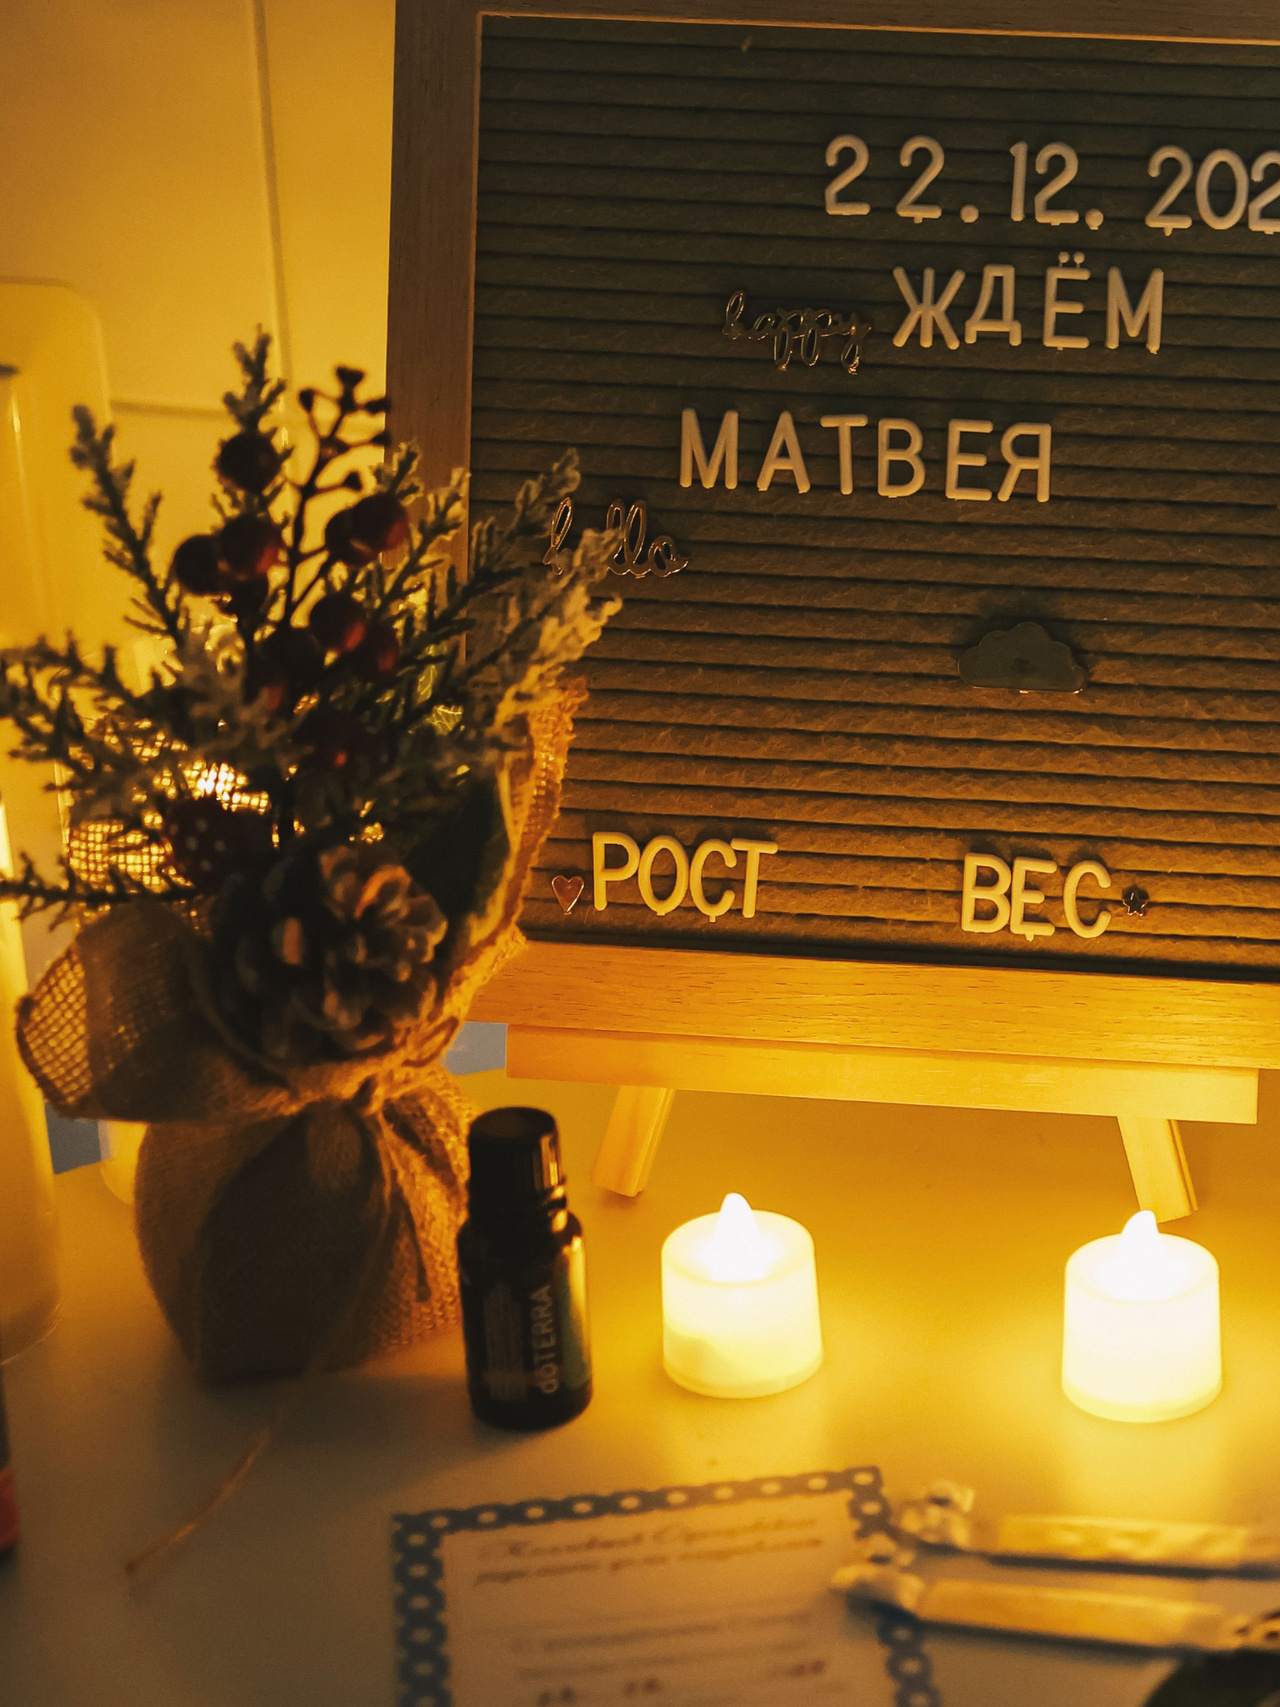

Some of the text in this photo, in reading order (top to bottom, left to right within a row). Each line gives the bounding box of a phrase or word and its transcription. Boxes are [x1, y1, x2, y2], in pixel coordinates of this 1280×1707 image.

[892, 251, 1165, 355] ЖДЁМ
[679, 407, 1053, 503] МАТВЕЯ
[543, 497, 688, 579] hllo
[592, 831, 778, 922] РОСТ
[960, 853, 1112, 942] ВЕС
